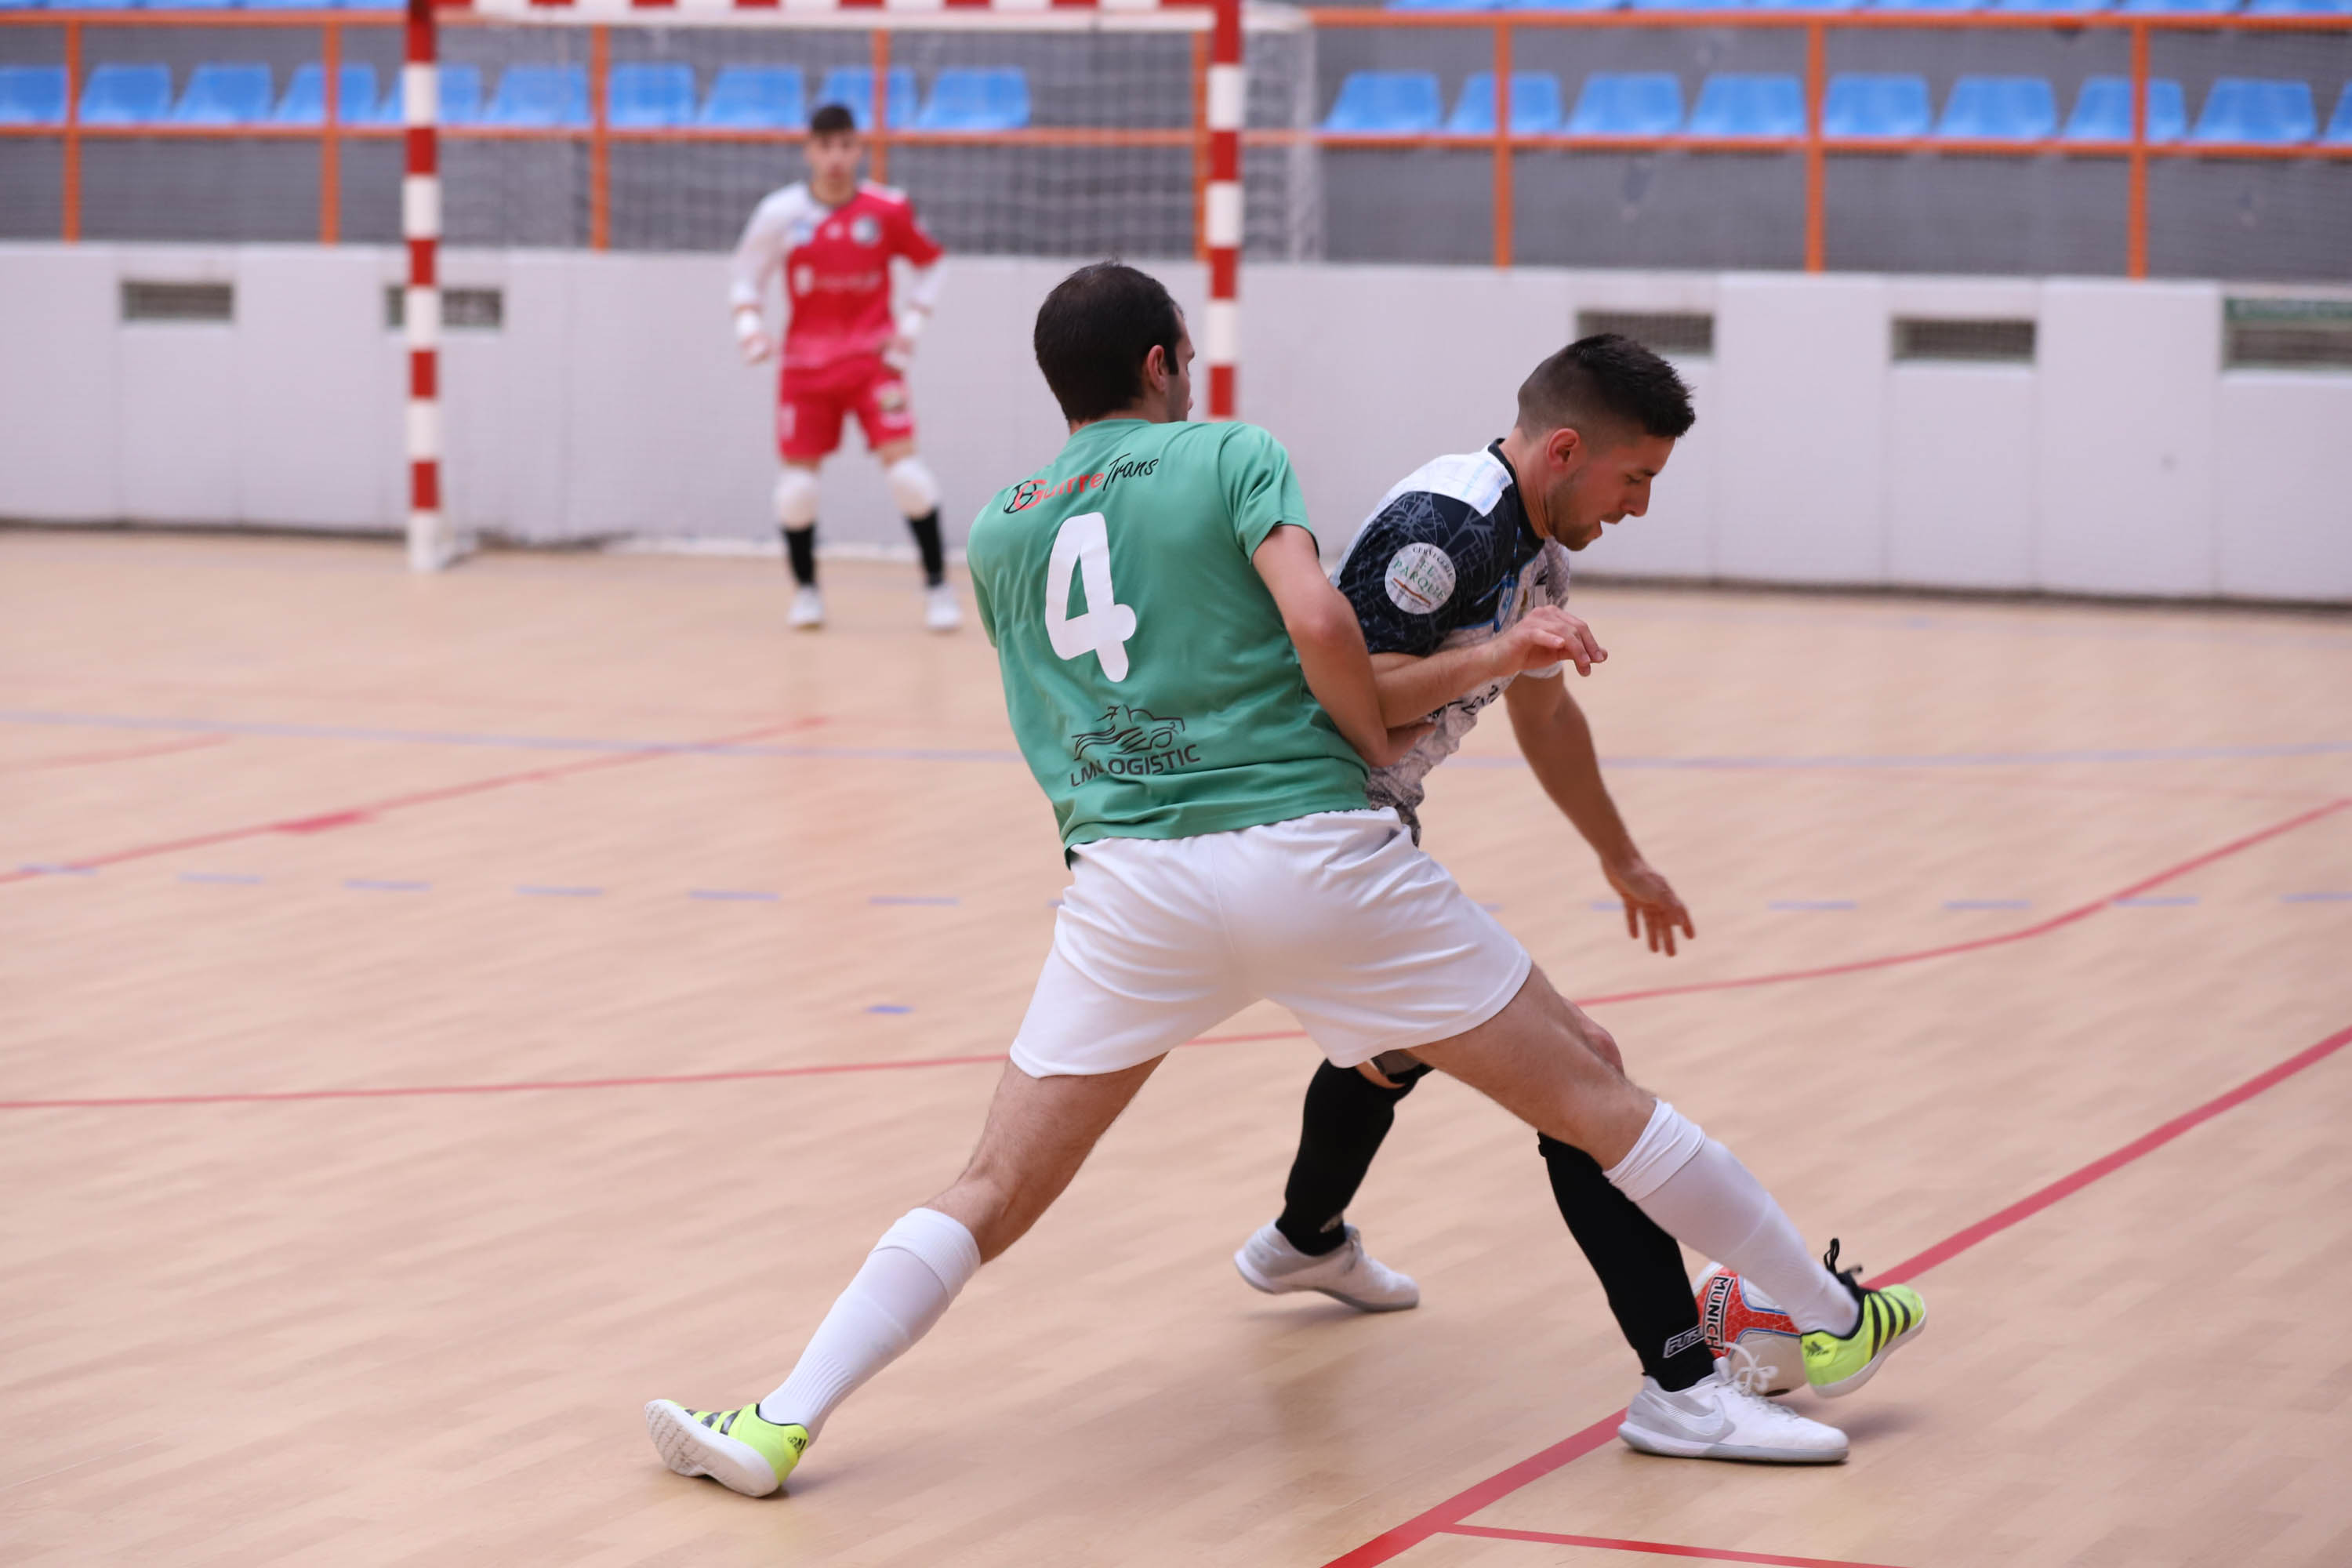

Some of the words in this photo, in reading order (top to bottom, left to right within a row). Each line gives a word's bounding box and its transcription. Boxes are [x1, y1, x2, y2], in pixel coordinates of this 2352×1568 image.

[1045, 511, 1137, 683] 4
[1392, 558, 1446, 599] PARQUE
[1705, 1276, 1730, 1351] MUNICH
